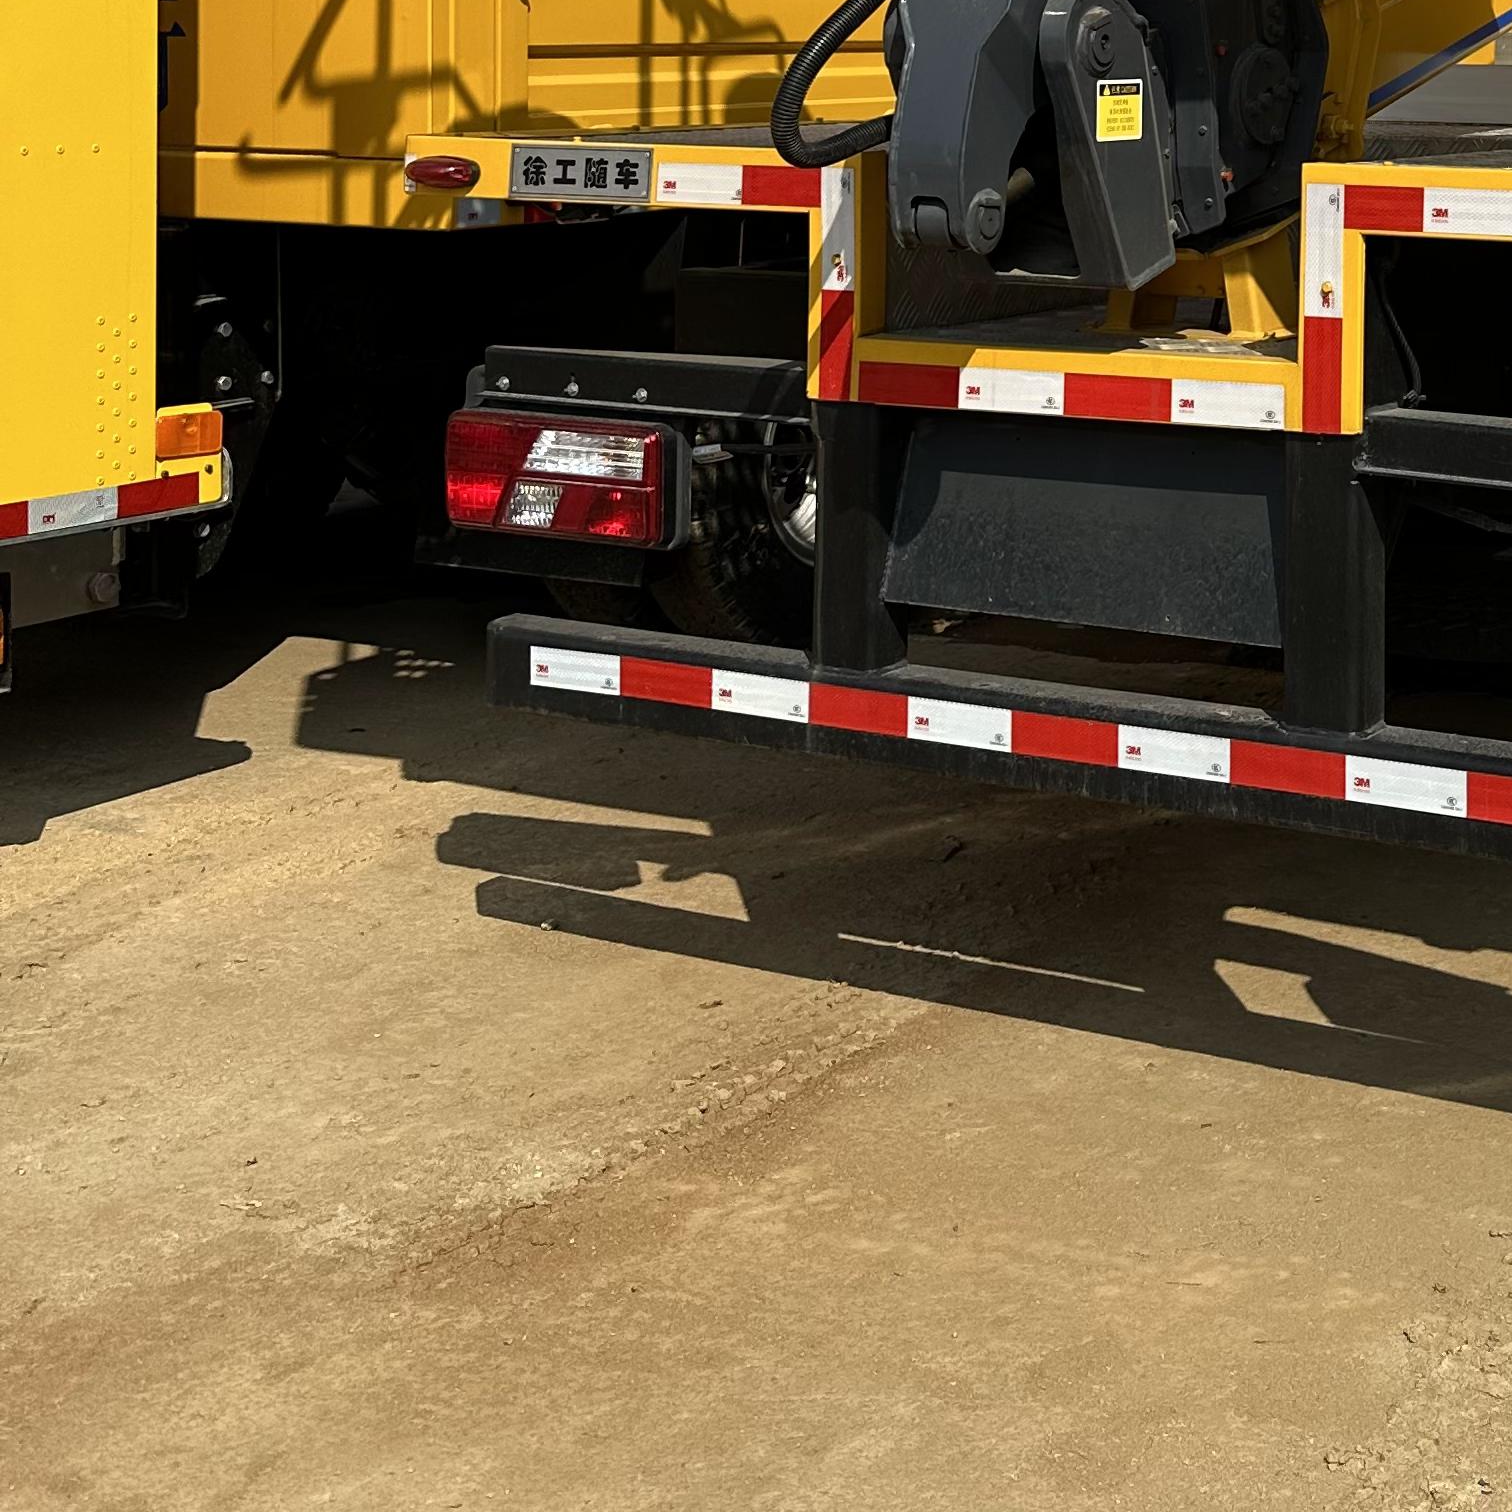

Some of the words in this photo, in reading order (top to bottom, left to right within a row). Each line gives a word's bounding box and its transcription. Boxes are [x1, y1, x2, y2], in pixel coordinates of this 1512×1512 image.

[523, 156, 640, 189] 徐工随车
[664, 181, 676, 189] 3M
[1432, 208, 1448, 217] 3M
[966, 386, 980, 395] 3M
[1179, 399, 1194, 408] 3M
[915, 717, 929, 726] 3M
[1126, 746, 1141, 755] 3M
[1354, 777, 1370, 787] 3M
